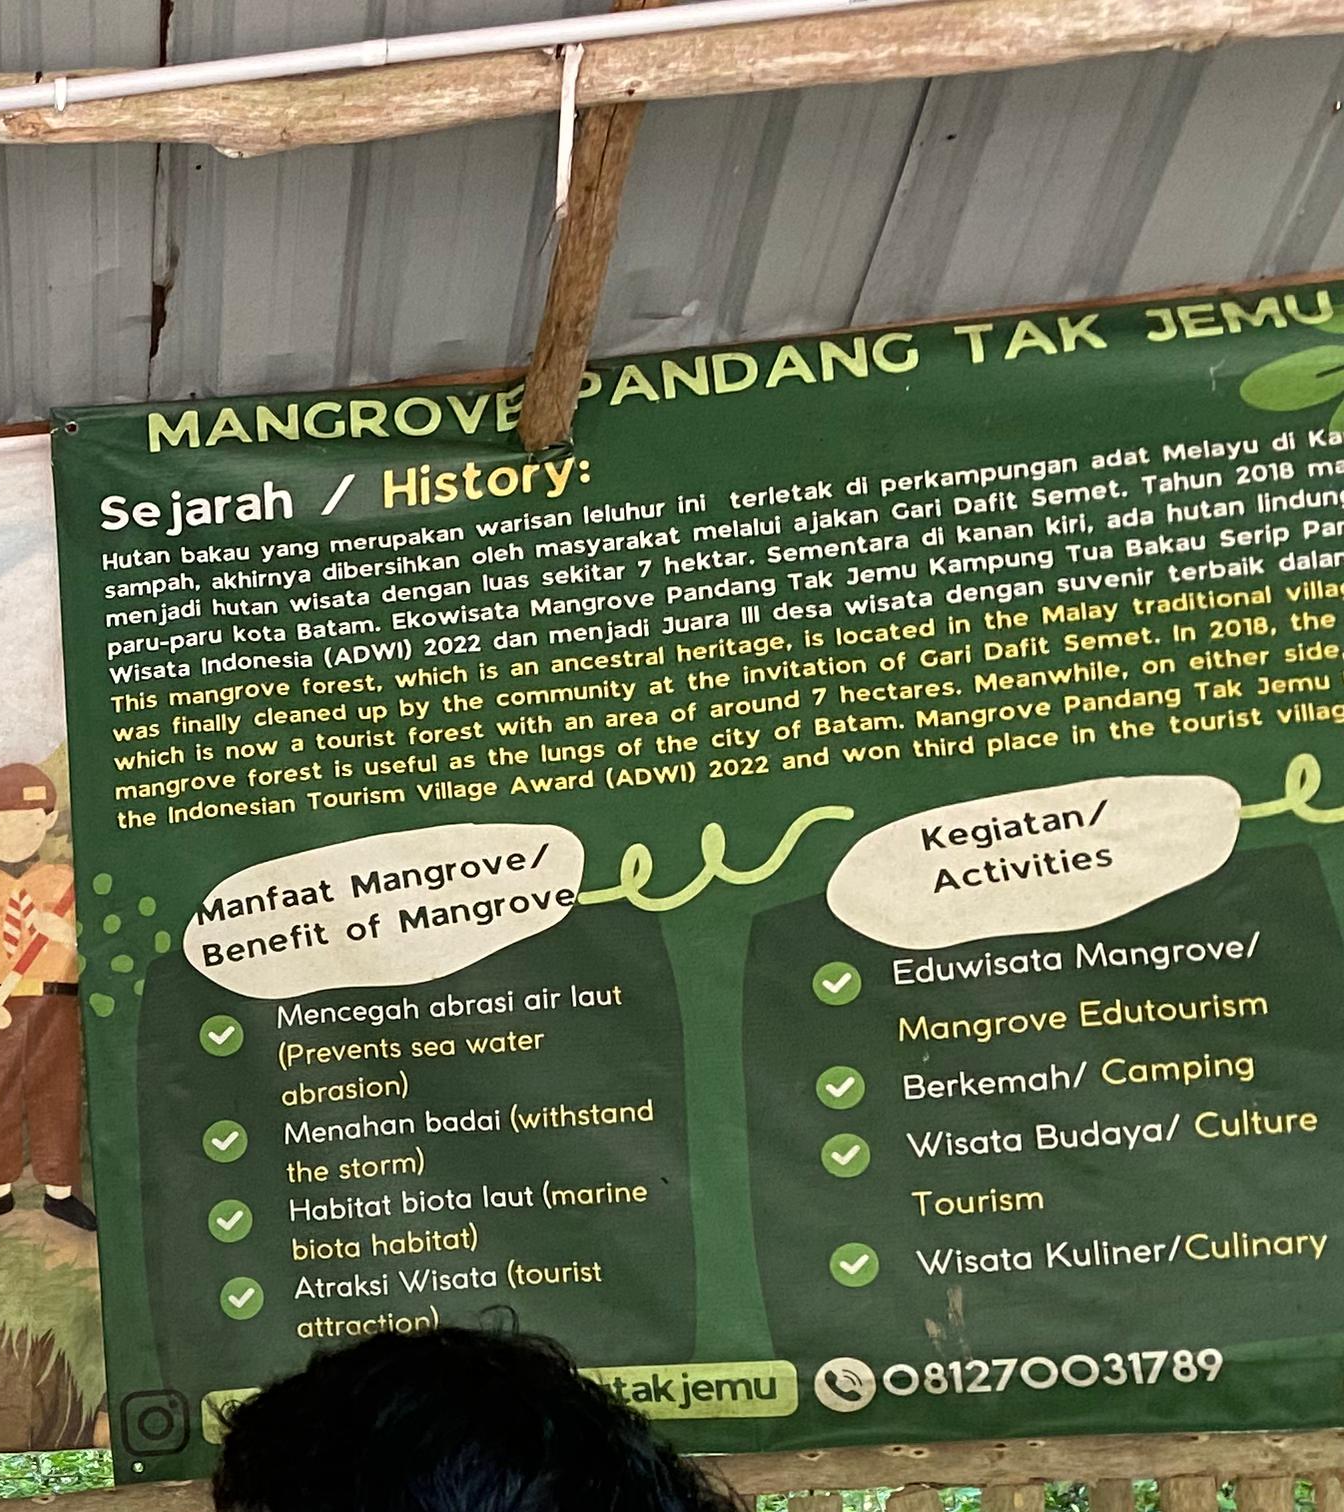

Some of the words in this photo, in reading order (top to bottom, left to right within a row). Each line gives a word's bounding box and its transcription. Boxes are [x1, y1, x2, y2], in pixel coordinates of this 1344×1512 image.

[954, 314, 1107, 363] TAK
[1145, 290, 1337, 342] JEMU
[101, 481, 292, 536] Sejarah
[384, 457, 590, 508] History:
[105, 573, 200, 598] sampah,
[212, 569, 310, 589] akhirnya
[323, 555, 459, 580] dibersihkan
[472, 543, 524, 564] oleh
[536, 527, 680, 558] masyarakat
[694, 515, 781, 541] melalui
[794, 509, 878, 534] ajakan
[892, 499, 941, 519] Gari
[954, 492, 1018, 515] Dafit
[1032, 480, 1127, 507] Semet.
[1141, 472, 1222, 495] Tahun
[1236, 462, 1294, 485] 2018
[108, 630, 222, 660] paru-paru
[233, 625, 286, 642] kota
[297, 620, 381, 640] Batam.
[392, 603, 519, 630] Ekowisata
[531, 593, 654, 616] Mangrove
[667, 578, 776, 604] Pandang
[787, 570, 833, 590] Tak
[847, 563, 916, 585] Jemu
[930, 550, 1053, 575] Kampung
[1065, 544, 1113, 562] Tua
[1126, 535, 1205, 557] Bakau
[1220, 524, 1289, 547] Serip
[109, 661, 190, 684] Wisata
[202, 651, 312, 675] Indonesia
[324, 639, 411, 668] (ADWI)
[424, 634, 481, 656] 2022
[494, 631, 537, 649] dan
[549, 619, 649, 644] menjadi
[662, 613, 729, 634] Juara
[742, 605, 760, 624] III
[773, 602, 832, 620] desa
[845, 591, 932, 615] wisata
[946, 580, 1043, 604] dengan
[1057, 567, 1153, 592] suvenir
[1168, 556, 1264, 582] terbaik
[113, 724, 160, 741] was
[173, 713, 241, 734] finally
[254, 704, 346, 726] cleaned
[358, 705, 387, 723] up
[399, 699, 429, 719] by
[442, 695, 483, 712] the
[497, 680, 636, 706] community
[650, 676, 674, 695] at
[688, 672, 730, 690] the
[743, 657, 866, 684] invitation
[880, 651, 906, 671] of
[920, 644, 971, 667] Gari
[984, 637, 1050, 661] Dafit
[1064, 627, 1160, 652] Semet.
[1173, 624, 1196, 642] In
[1210, 616, 1276, 639] 2018,
[1290, 612, 1336, 631] the
[117, 810, 156, 829] the
[169, 797, 295, 823] Indonesian
[307, 787, 405, 810] Tourism
[417, 781, 497, 801] Village
[511, 770, 593, 794] Award
[606, 761, 696, 789] (ADWI)
[709, 756, 769, 778] 2022
[783, 747, 829, 770] and
[842, 745, 900, 762] won
[913, 736, 974, 757] third
[987, 732, 1058, 757] place
[1072, 725, 1095, 744] in
[1110, 720, 1155, 740] the
[1170, 708, 1263, 734] tourist
[922, 800, 1107, 854] Kegiatan/
[196, 880, 334, 927] Manfaat
[351, 843, 548, 898] Mangrove/
[934, 849, 1112, 893] Activities
[203, 923, 329, 966] Benefit
[347, 913, 380, 940] of
[400, 888, 575, 934] Mangrove
[894, 950, 1061, 984] Eduwisata
[1077, 931, 1259, 969] Mangrove/
[278, 998, 418, 1028] Mencegah
[430, 991, 513, 1017] abrasi
[525, 988, 560, 1010] air
[572, 985, 621, 1007] laut
[900, 1012, 1066, 1042] Mangrove
[1081, 995, 1267, 1026] Edutourism
[279, 1039, 401, 1070] (Prevents
[412, 1040, 455, 1056] sea
[466, 1032, 544, 1053] water
[282, 1071, 407, 1106] abrasion)
[904, 1061, 1087, 1099] Berkemah/
[1102, 1054, 1253, 1085] Camping
[286, 1115, 414, 1144] Menahan
[426, 1110, 500, 1132] badai
[511, 1099, 653, 1132] (withstand
[907, 1130, 1022, 1157] Wisata
[1036, 1114, 1179, 1150] Budaya/
[1195, 1110, 1317, 1138] Culture
[287, 1161, 328, 1182] the
[340, 1147, 424, 1179] storm)
[290, 1195, 391, 1221] Habitat
[402, 1190, 471, 1213] biota
[483, 1186, 533, 1207] laut
[543, 1180, 647, 1209] (marine
[912, 1189, 1043, 1216] Tourism
[293, 1239, 360, 1260] biota
[372, 1222, 477, 1256] habitat)
[916, 1249, 1031, 1275] Wisata
[295, 1274, 387, 1299] Atraksi
[399, 1268, 496, 1293] Wisata
[508, 1260, 601, 1288] (tourist
[296, 1306, 439, 1339] attraction)
[883, 1348, 1223, 1395] 081270031789
